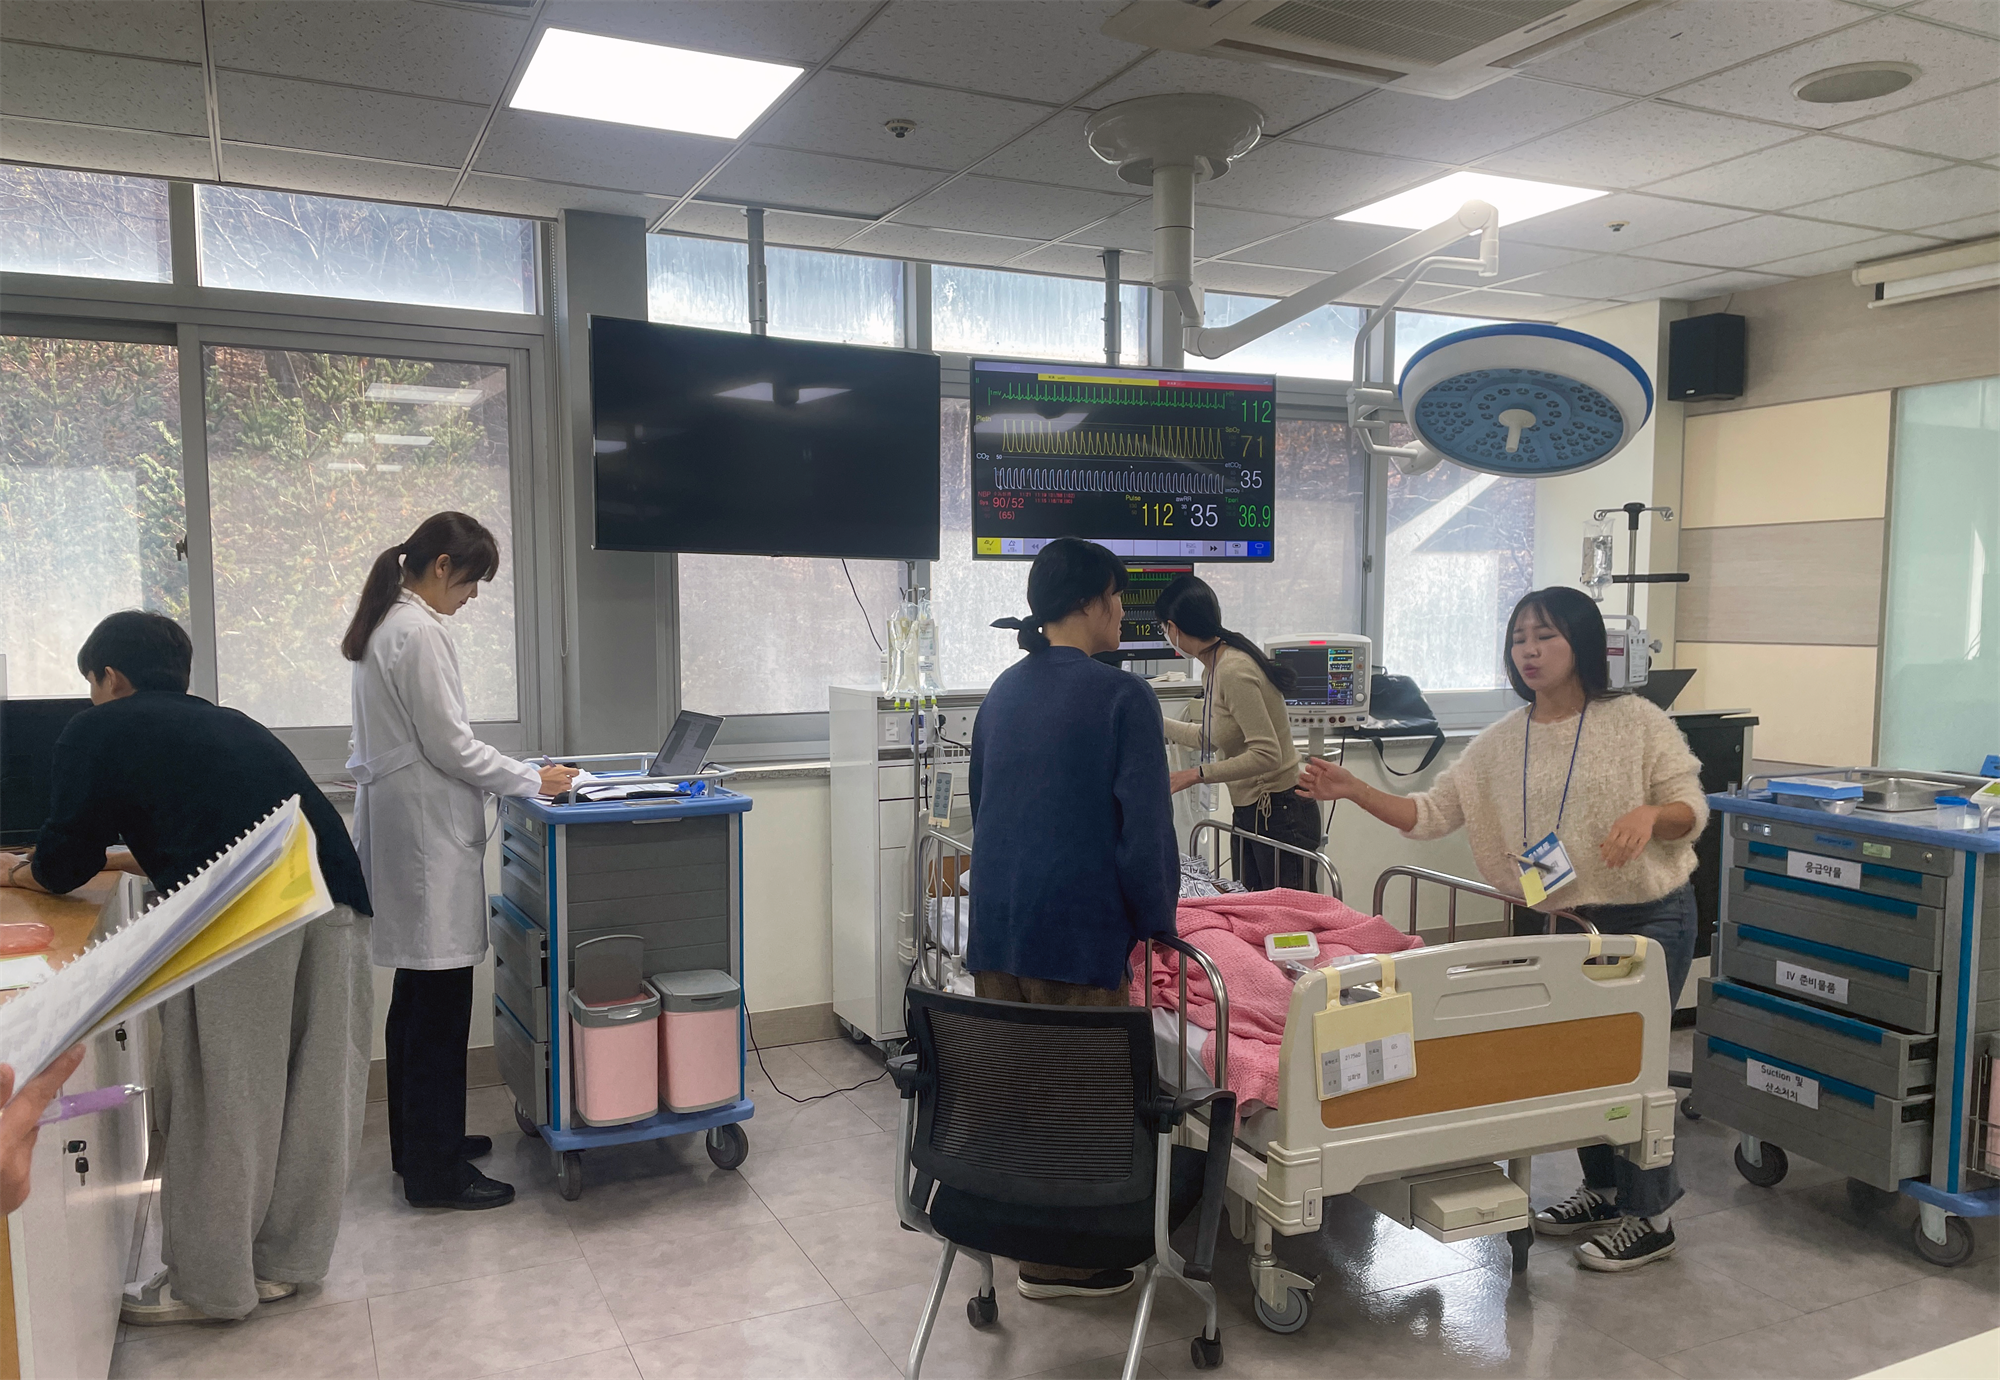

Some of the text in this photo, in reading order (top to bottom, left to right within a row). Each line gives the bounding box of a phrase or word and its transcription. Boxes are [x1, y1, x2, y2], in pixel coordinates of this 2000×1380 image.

[1241, 399, 1272, 423] 112
[1240, 434, 1264, 458] 71
[1240, 469, 1263, 489] 35
[992, 497, 1025, 508] 90/52
[998, 511, 1015, 520] (65)
[1142, 502, 1174, 527] 112
[1190, 503, 1219, 527] 35
[1238, 504, 1271, 528] 36.9
[1136, 624, 1151, 636] 112
[1805, 861, 1842, 879] 응급약물
[1786, 970, 1836, 995] IV 준비물품
[1760, 1065, 1804, 1088] Suction 및
